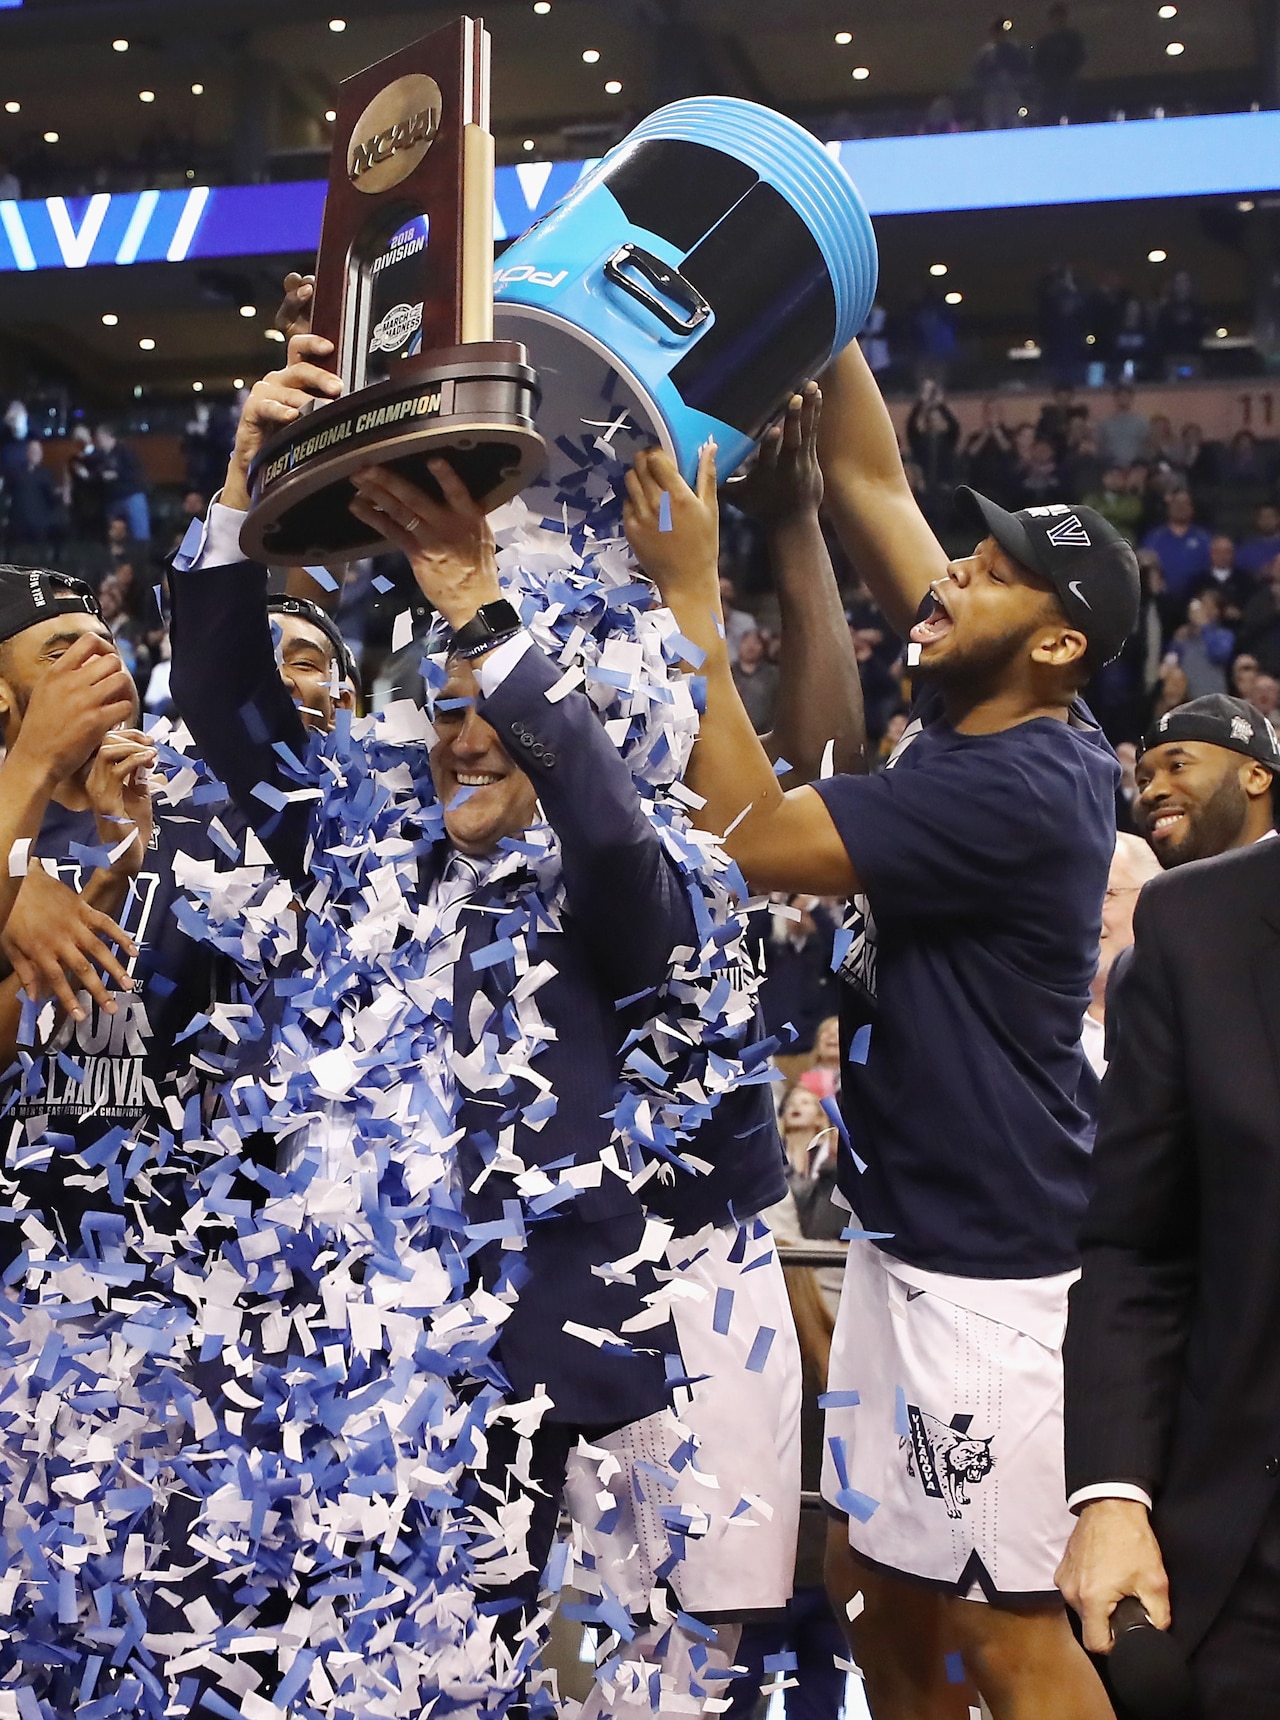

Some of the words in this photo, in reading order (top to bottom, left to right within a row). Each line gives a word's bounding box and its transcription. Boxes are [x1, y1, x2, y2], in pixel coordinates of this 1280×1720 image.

[351, 107, 438, 179] NCAA
[373, 235, 425, 274] DIVISION
[390, 227, 415, 250] 2018
[382, 311, 410, 331] MARCH
[265, 451, 291, 486] EAST
[292, 419, 353, 464] REGIONAL
[355, 392, 441, 434] CHAMPION
[911, 1414, 936, 1490] VILLANOVA
